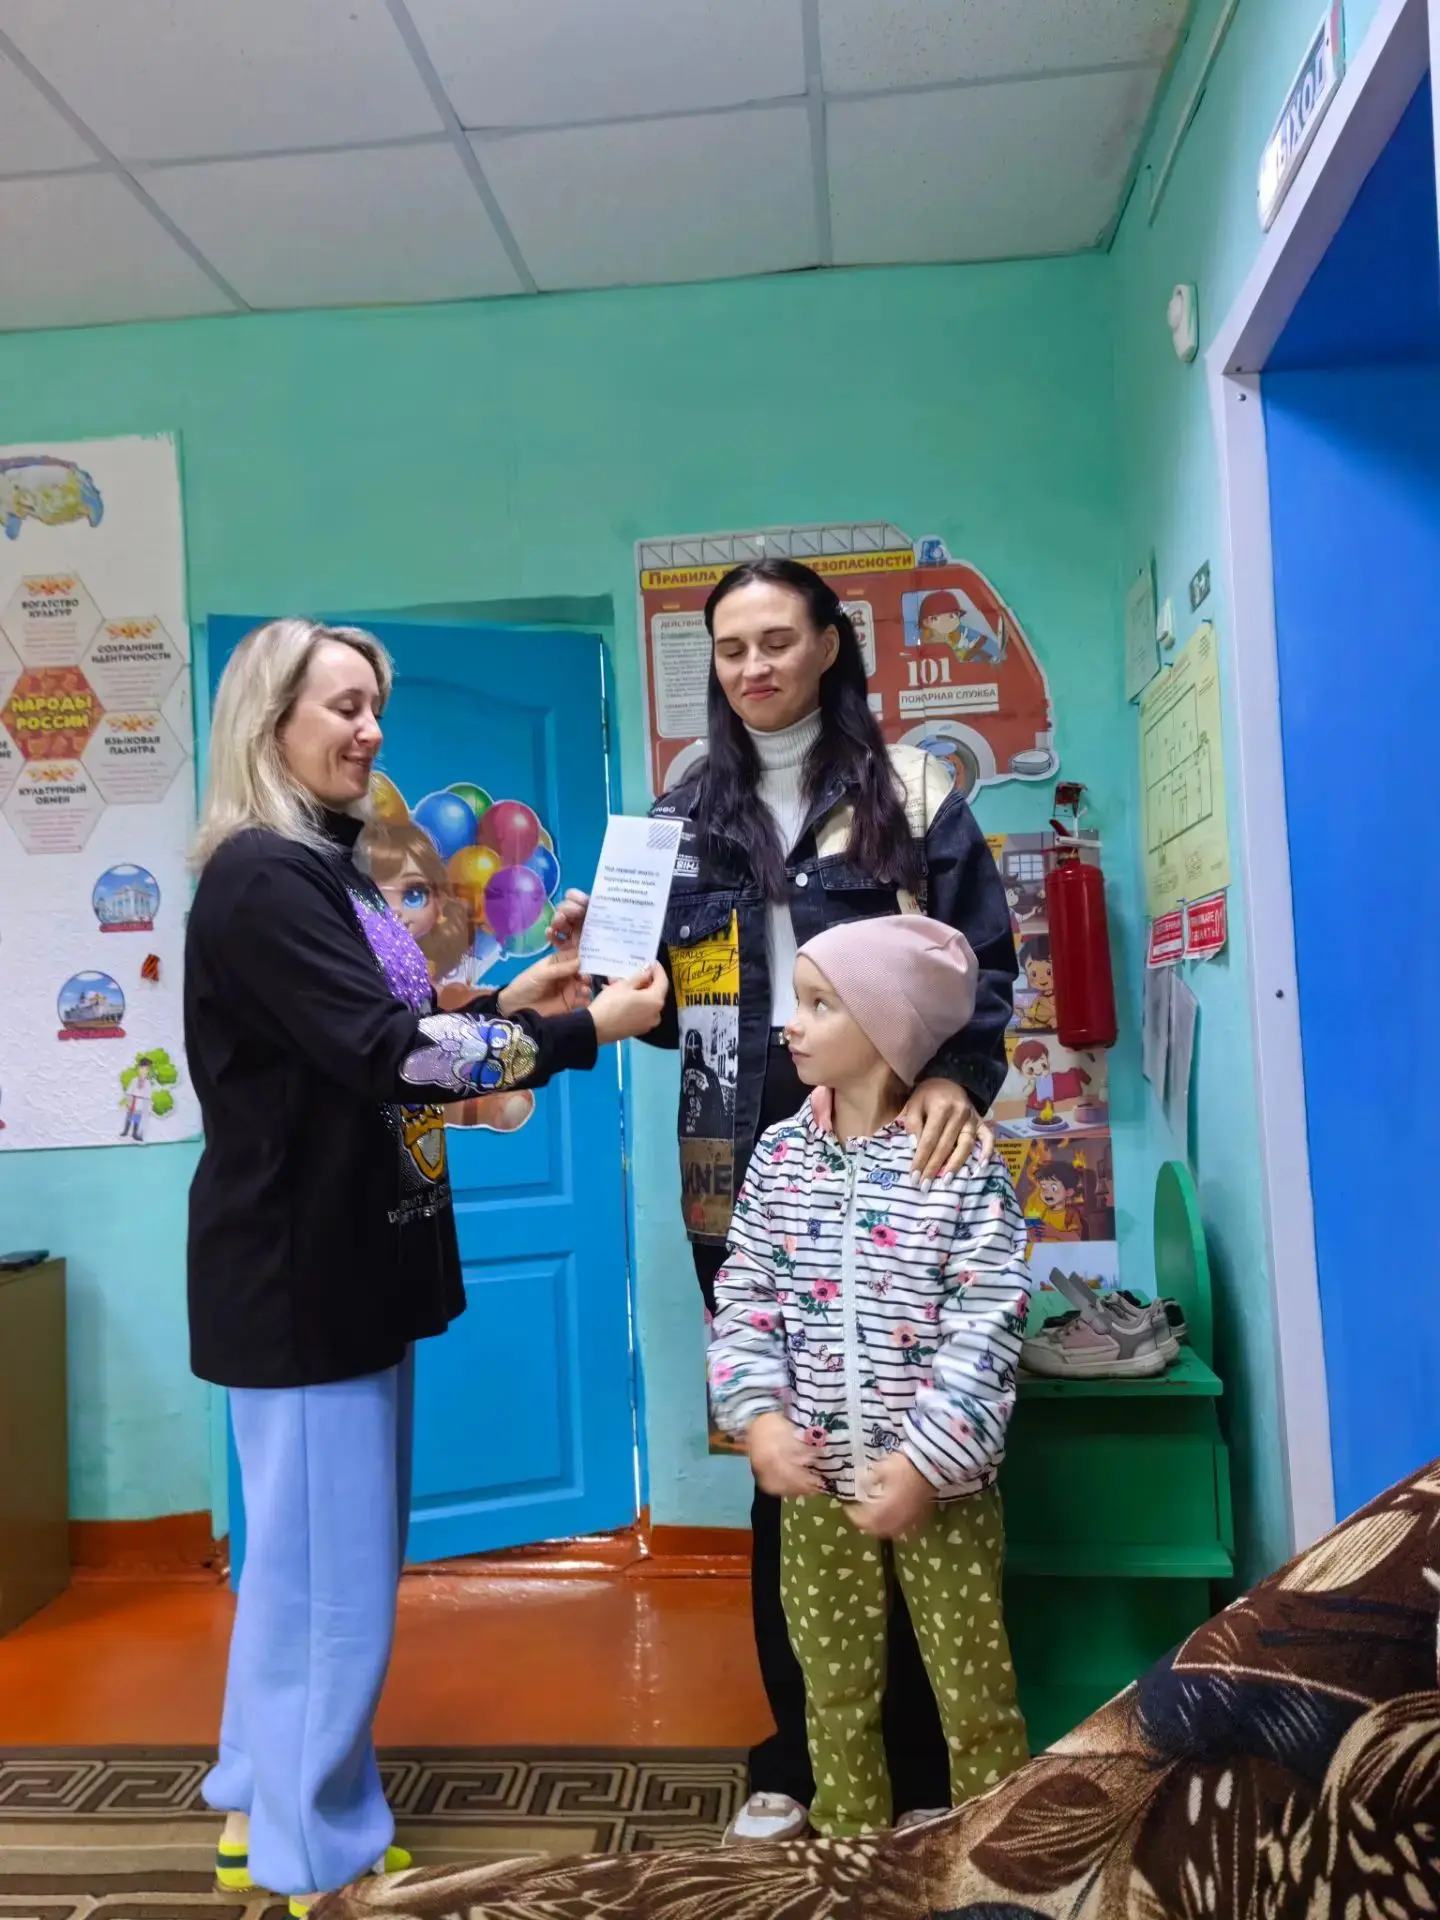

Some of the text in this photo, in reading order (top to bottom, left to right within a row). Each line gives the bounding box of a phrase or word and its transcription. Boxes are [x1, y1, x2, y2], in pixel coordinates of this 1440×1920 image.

[807, 556, 911, 572] ЕЗОПАСНОСТИ
[22, 599, 79, 609] БОГАТСТВО
[29, 608, 72, 618] КУЛЬТУР
[97, 643, 164, 654] СОХРАНЕНИЕ
[91, 651, 171, 664] ИДЕНТИЧНОСТИ
[907, 657, 952, 686] 101
[901, 688, 996, 704] ПОЖАРНАЯ СЛУЖБА
[12, 695, 92, 713] НАРОДЫ
[16, 714, 89, 730] РОССИИ
[104, 736, 161, 746] ЯЗЫКОВАЯ
[109, 745, 156, 756] ПАЛИТРА
[19, 784, 86, 797] КУЛЬТУРНЫЙ
[35, 795, 70, 805] ОБМЕН
